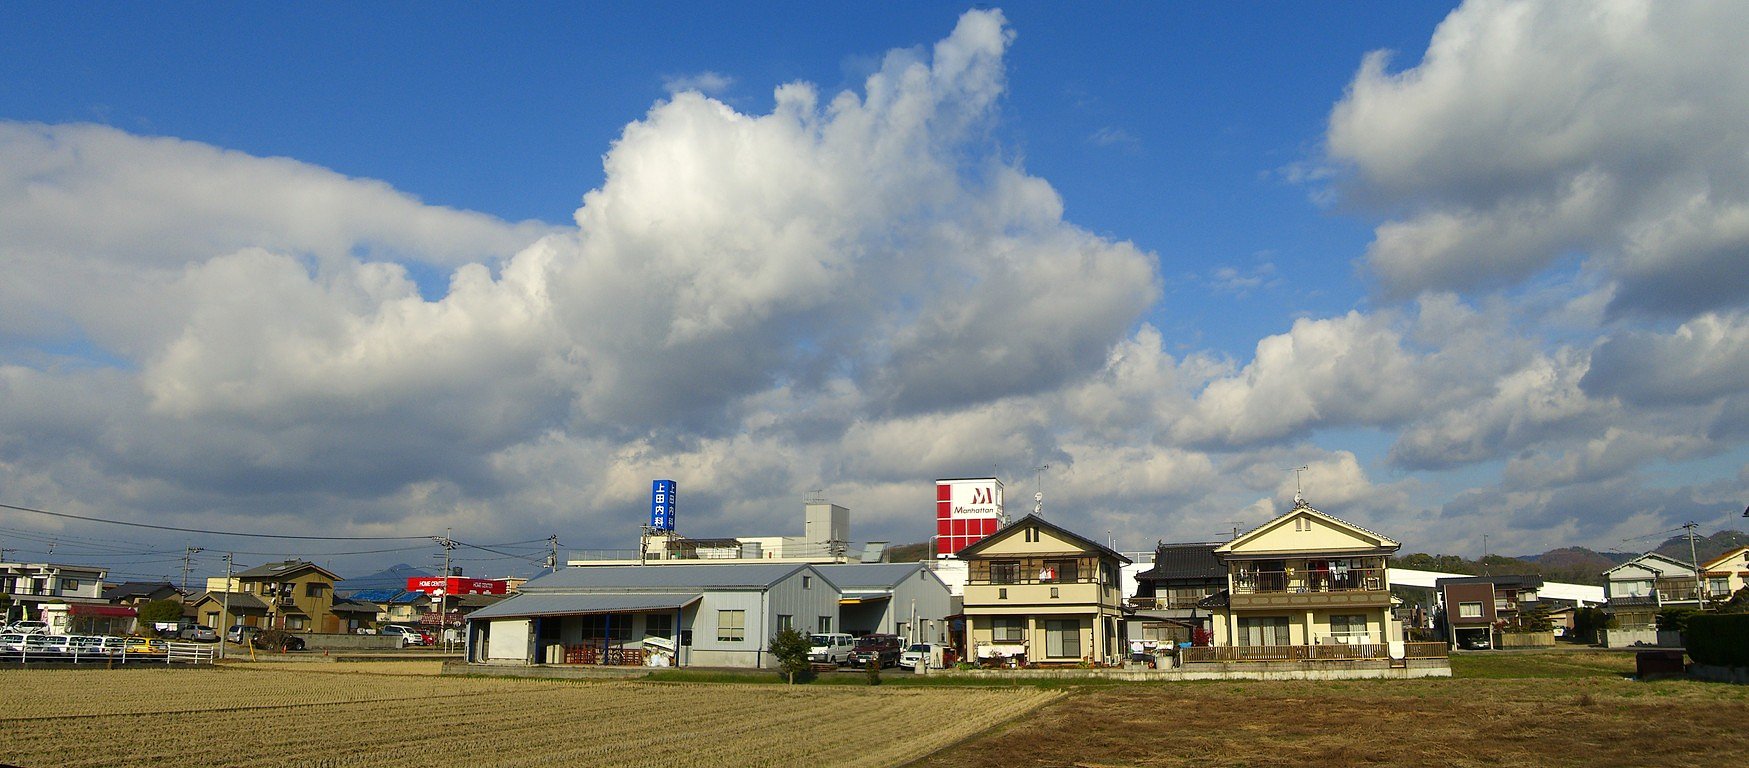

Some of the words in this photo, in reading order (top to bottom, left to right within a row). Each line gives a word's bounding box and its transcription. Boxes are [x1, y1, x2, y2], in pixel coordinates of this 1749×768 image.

[654, 482, 665, 527] 上田内科
[954, 506, 994, 514] Manhattan
